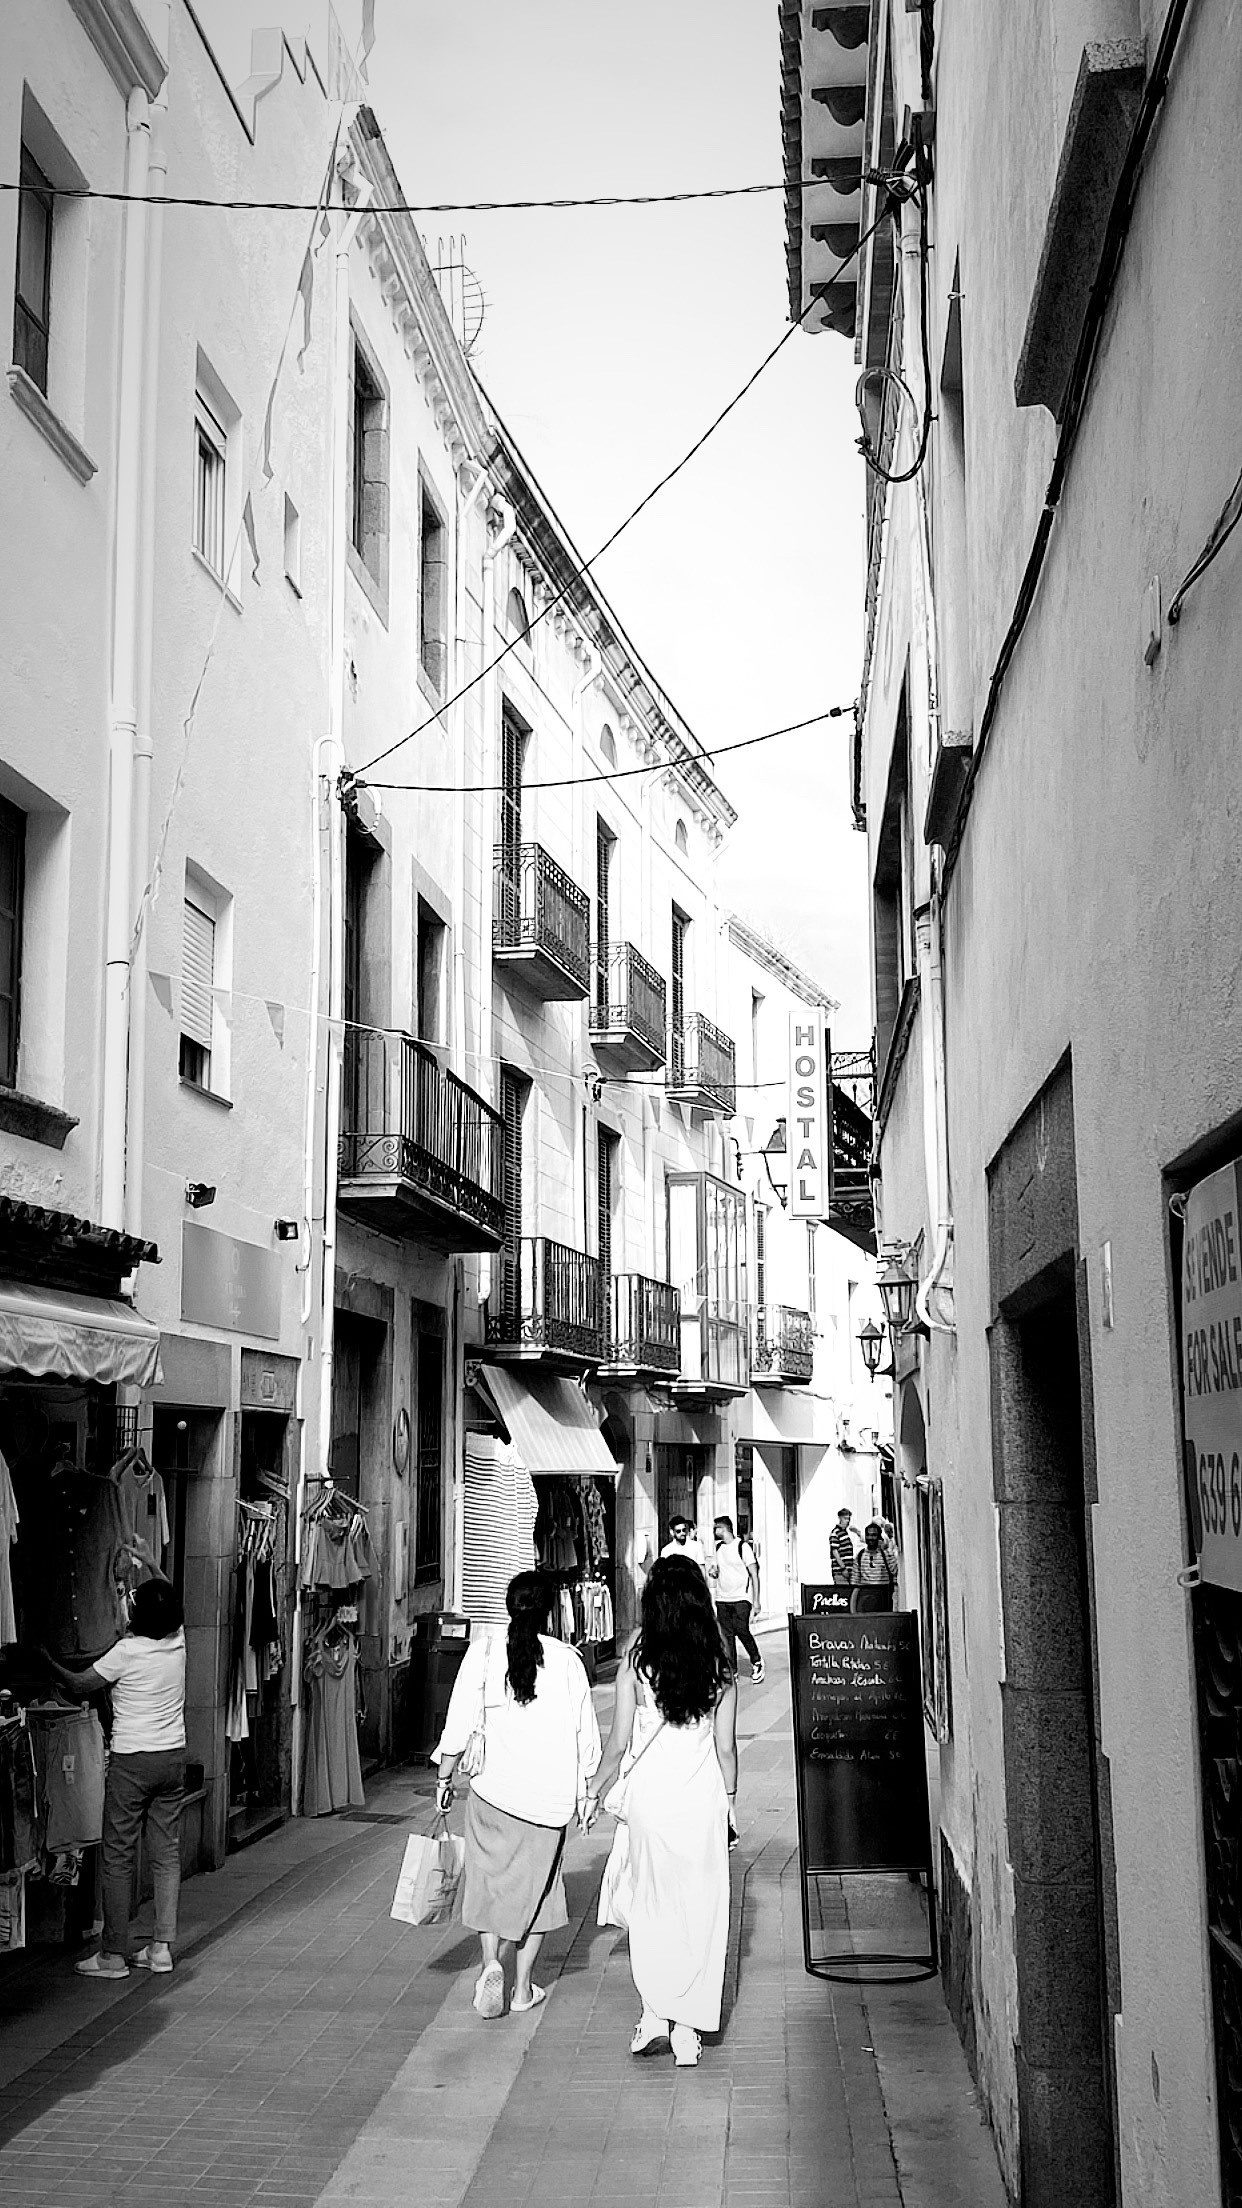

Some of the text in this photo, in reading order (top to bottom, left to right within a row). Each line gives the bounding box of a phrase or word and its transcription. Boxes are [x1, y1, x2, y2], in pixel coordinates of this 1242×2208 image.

[795, 1026, 817, 1200] HOSTAL
[1188, 1316, 1242, 1397] FOR SALE
[1200, 1452, 1226, 1536] 639
[809, 1632, 855, 1650] Bravas
